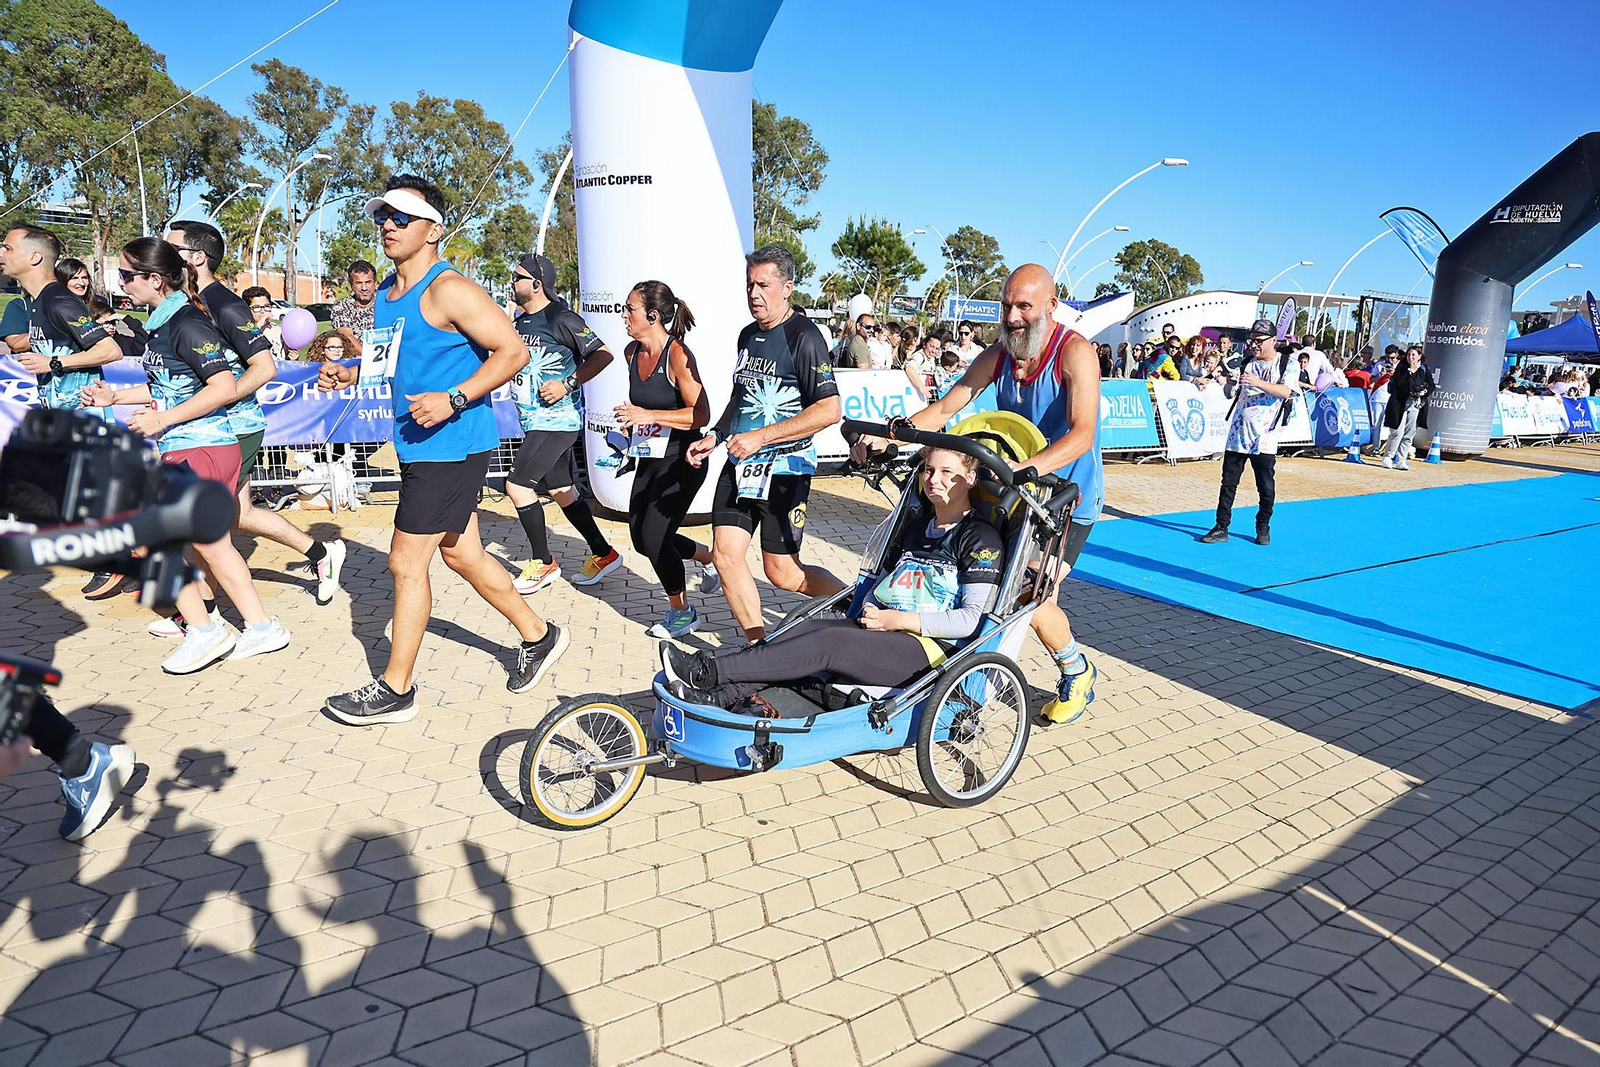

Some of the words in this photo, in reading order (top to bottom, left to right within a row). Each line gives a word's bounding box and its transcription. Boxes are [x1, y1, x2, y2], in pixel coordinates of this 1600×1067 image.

[576, 177, 607, 189] ATLANTIC
[608, 174, 653, 186] COPPER
[1510, 211, 1522, 219] DE
[1525, 211, 1562, 219] HUELVA
[582, 302, 613, 314] ATLANTIC
[964, 305, 996, 314] SIMATEC
[1427, 322, 1457, 333] Huelva
[1459, 323, 1488, 335] eleva
[1437, 335, 1487, 347] sentidos.
[742, 355, 777, 376] HUELVA
[1106, 395, 1146, 417] HUELVA
[1430, 400, 1466, 410] HUELVA
[357, 405, 394, 422] syrlu
[587, 421, 616, 435] ATLANT
[638, 423, 663, 437] 532
[30, 523, 136, 566] RONIN
